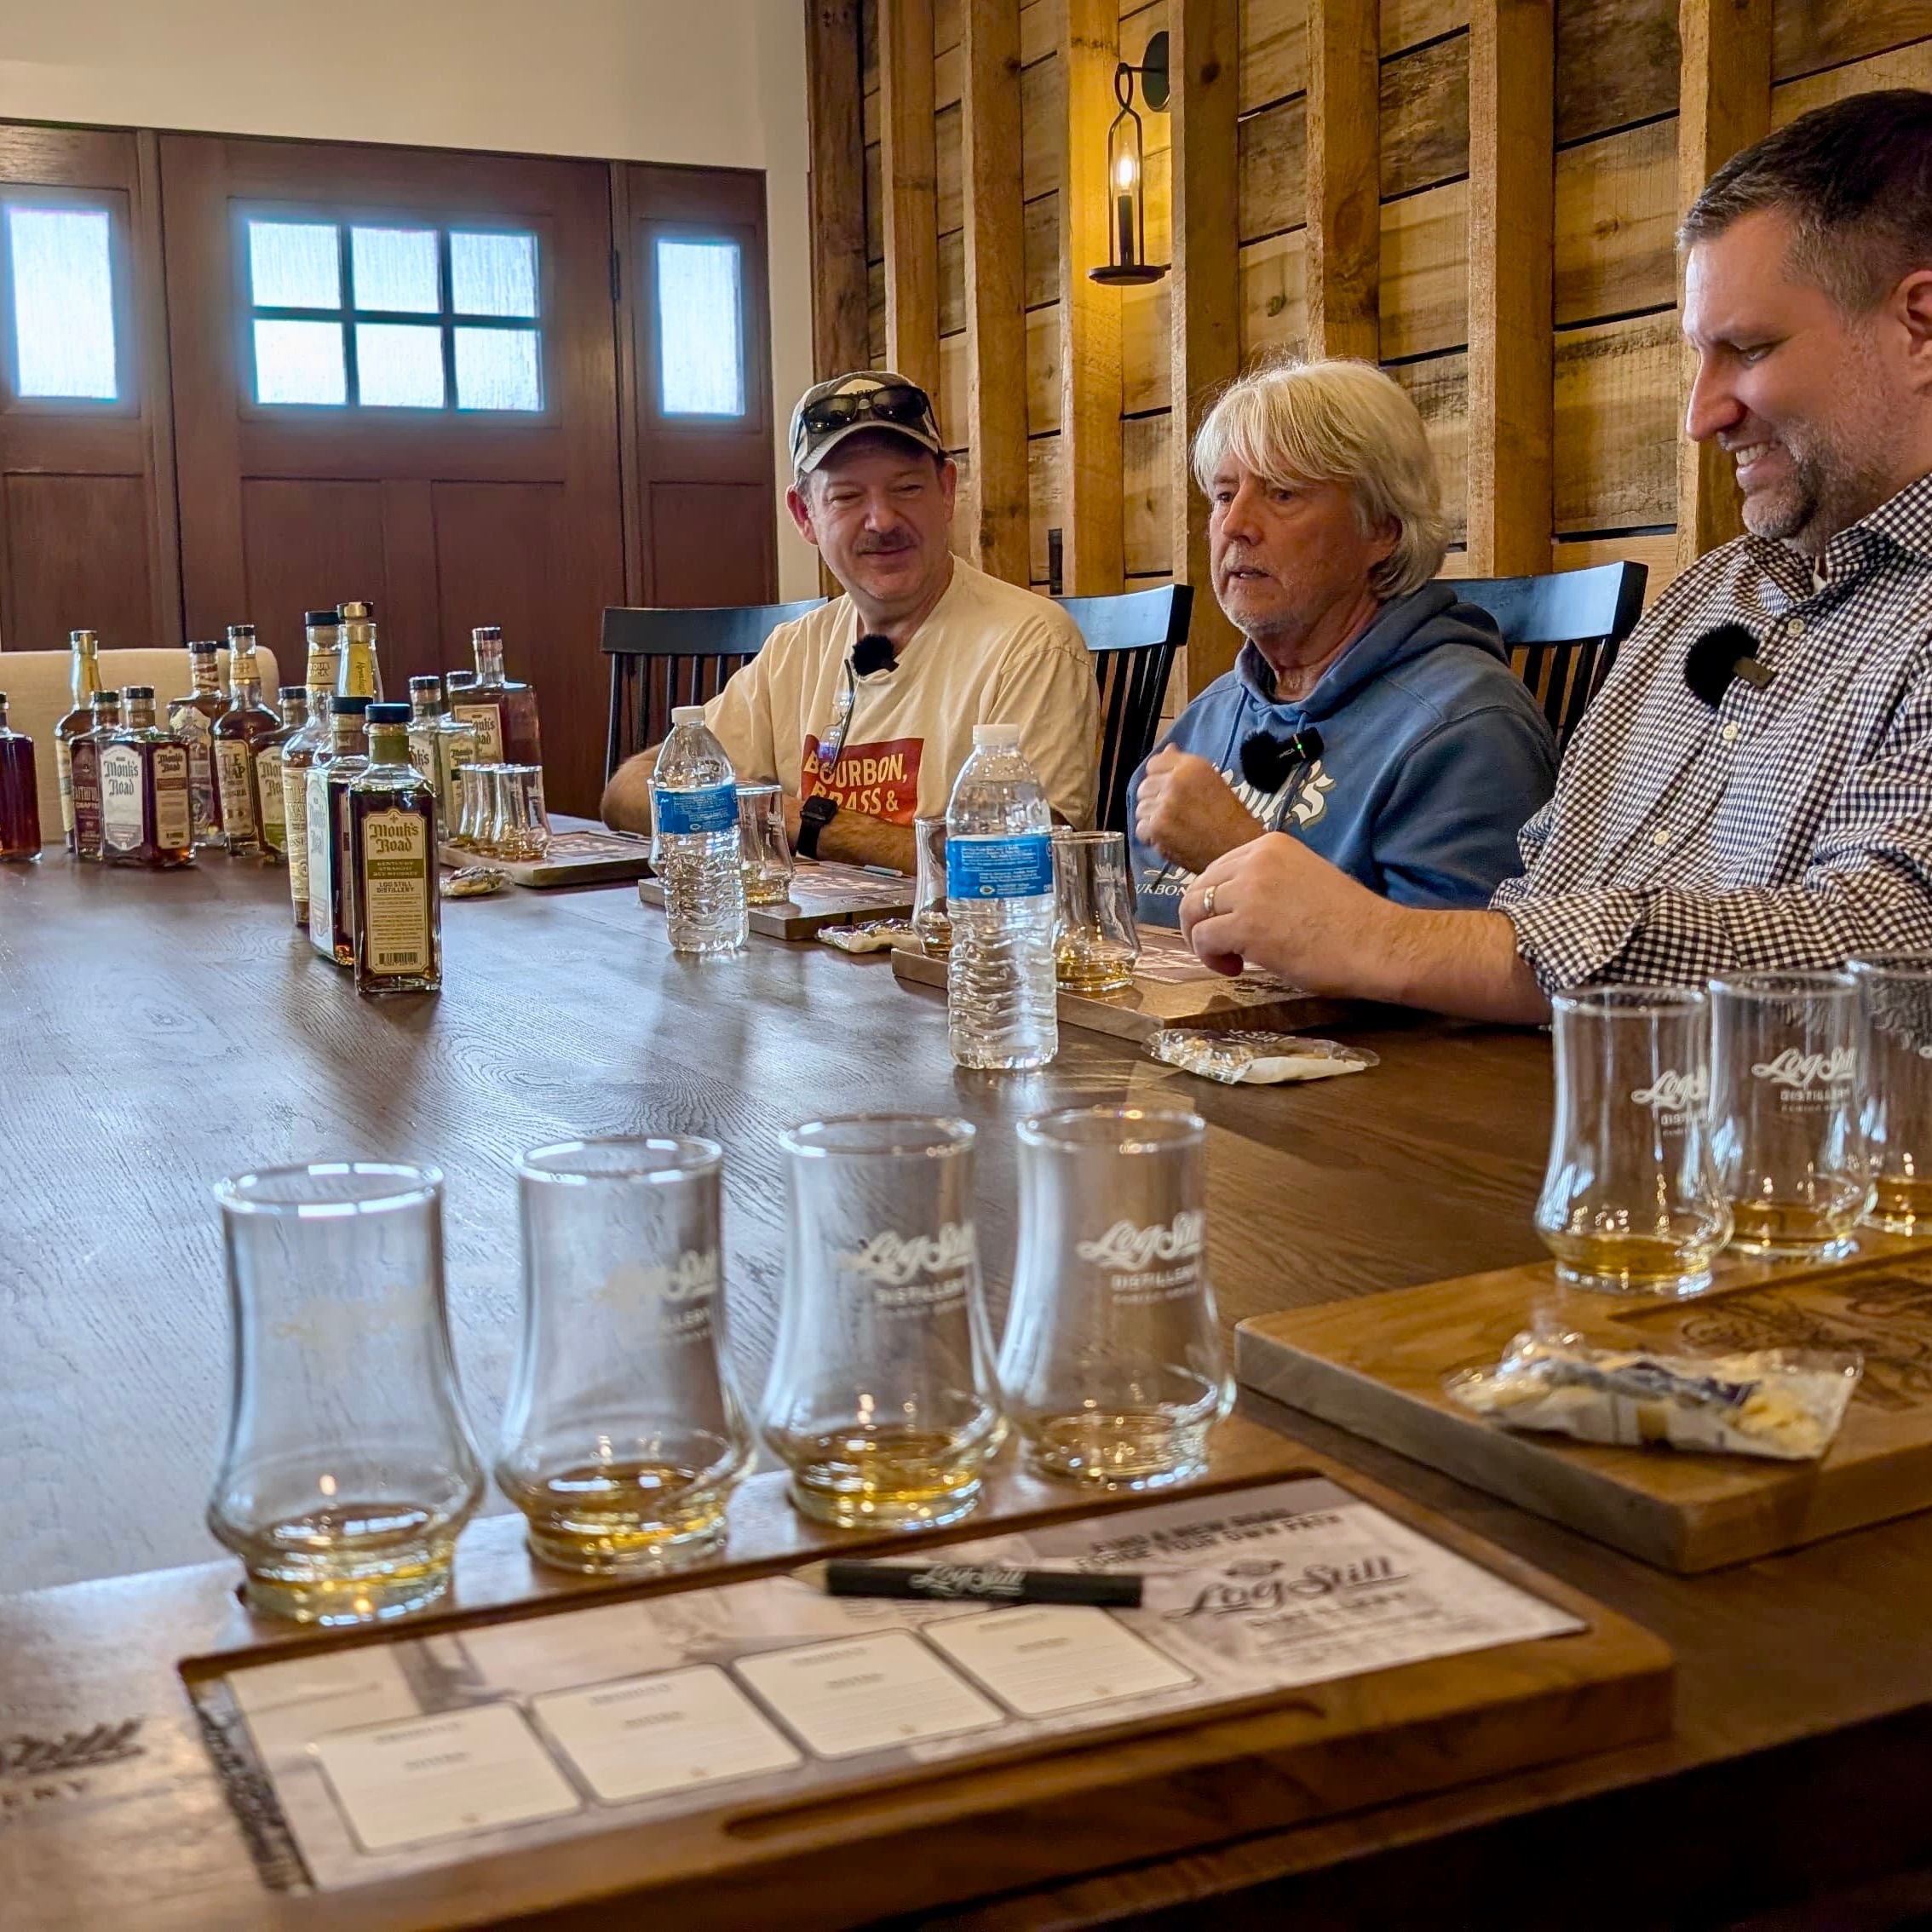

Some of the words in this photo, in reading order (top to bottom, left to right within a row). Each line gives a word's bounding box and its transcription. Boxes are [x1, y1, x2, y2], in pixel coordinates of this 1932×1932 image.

[104, 760, 139, 777] Monk's
[803, 753, 907, 789] BOURBON,
[108, 779, 135, 796] Road
[885, 791, 899, 812] &
[369, 822, 419, 839] Monk's
[376, 837, 412, 854] Road
[1286, 1555, 1411, 1601] Still
